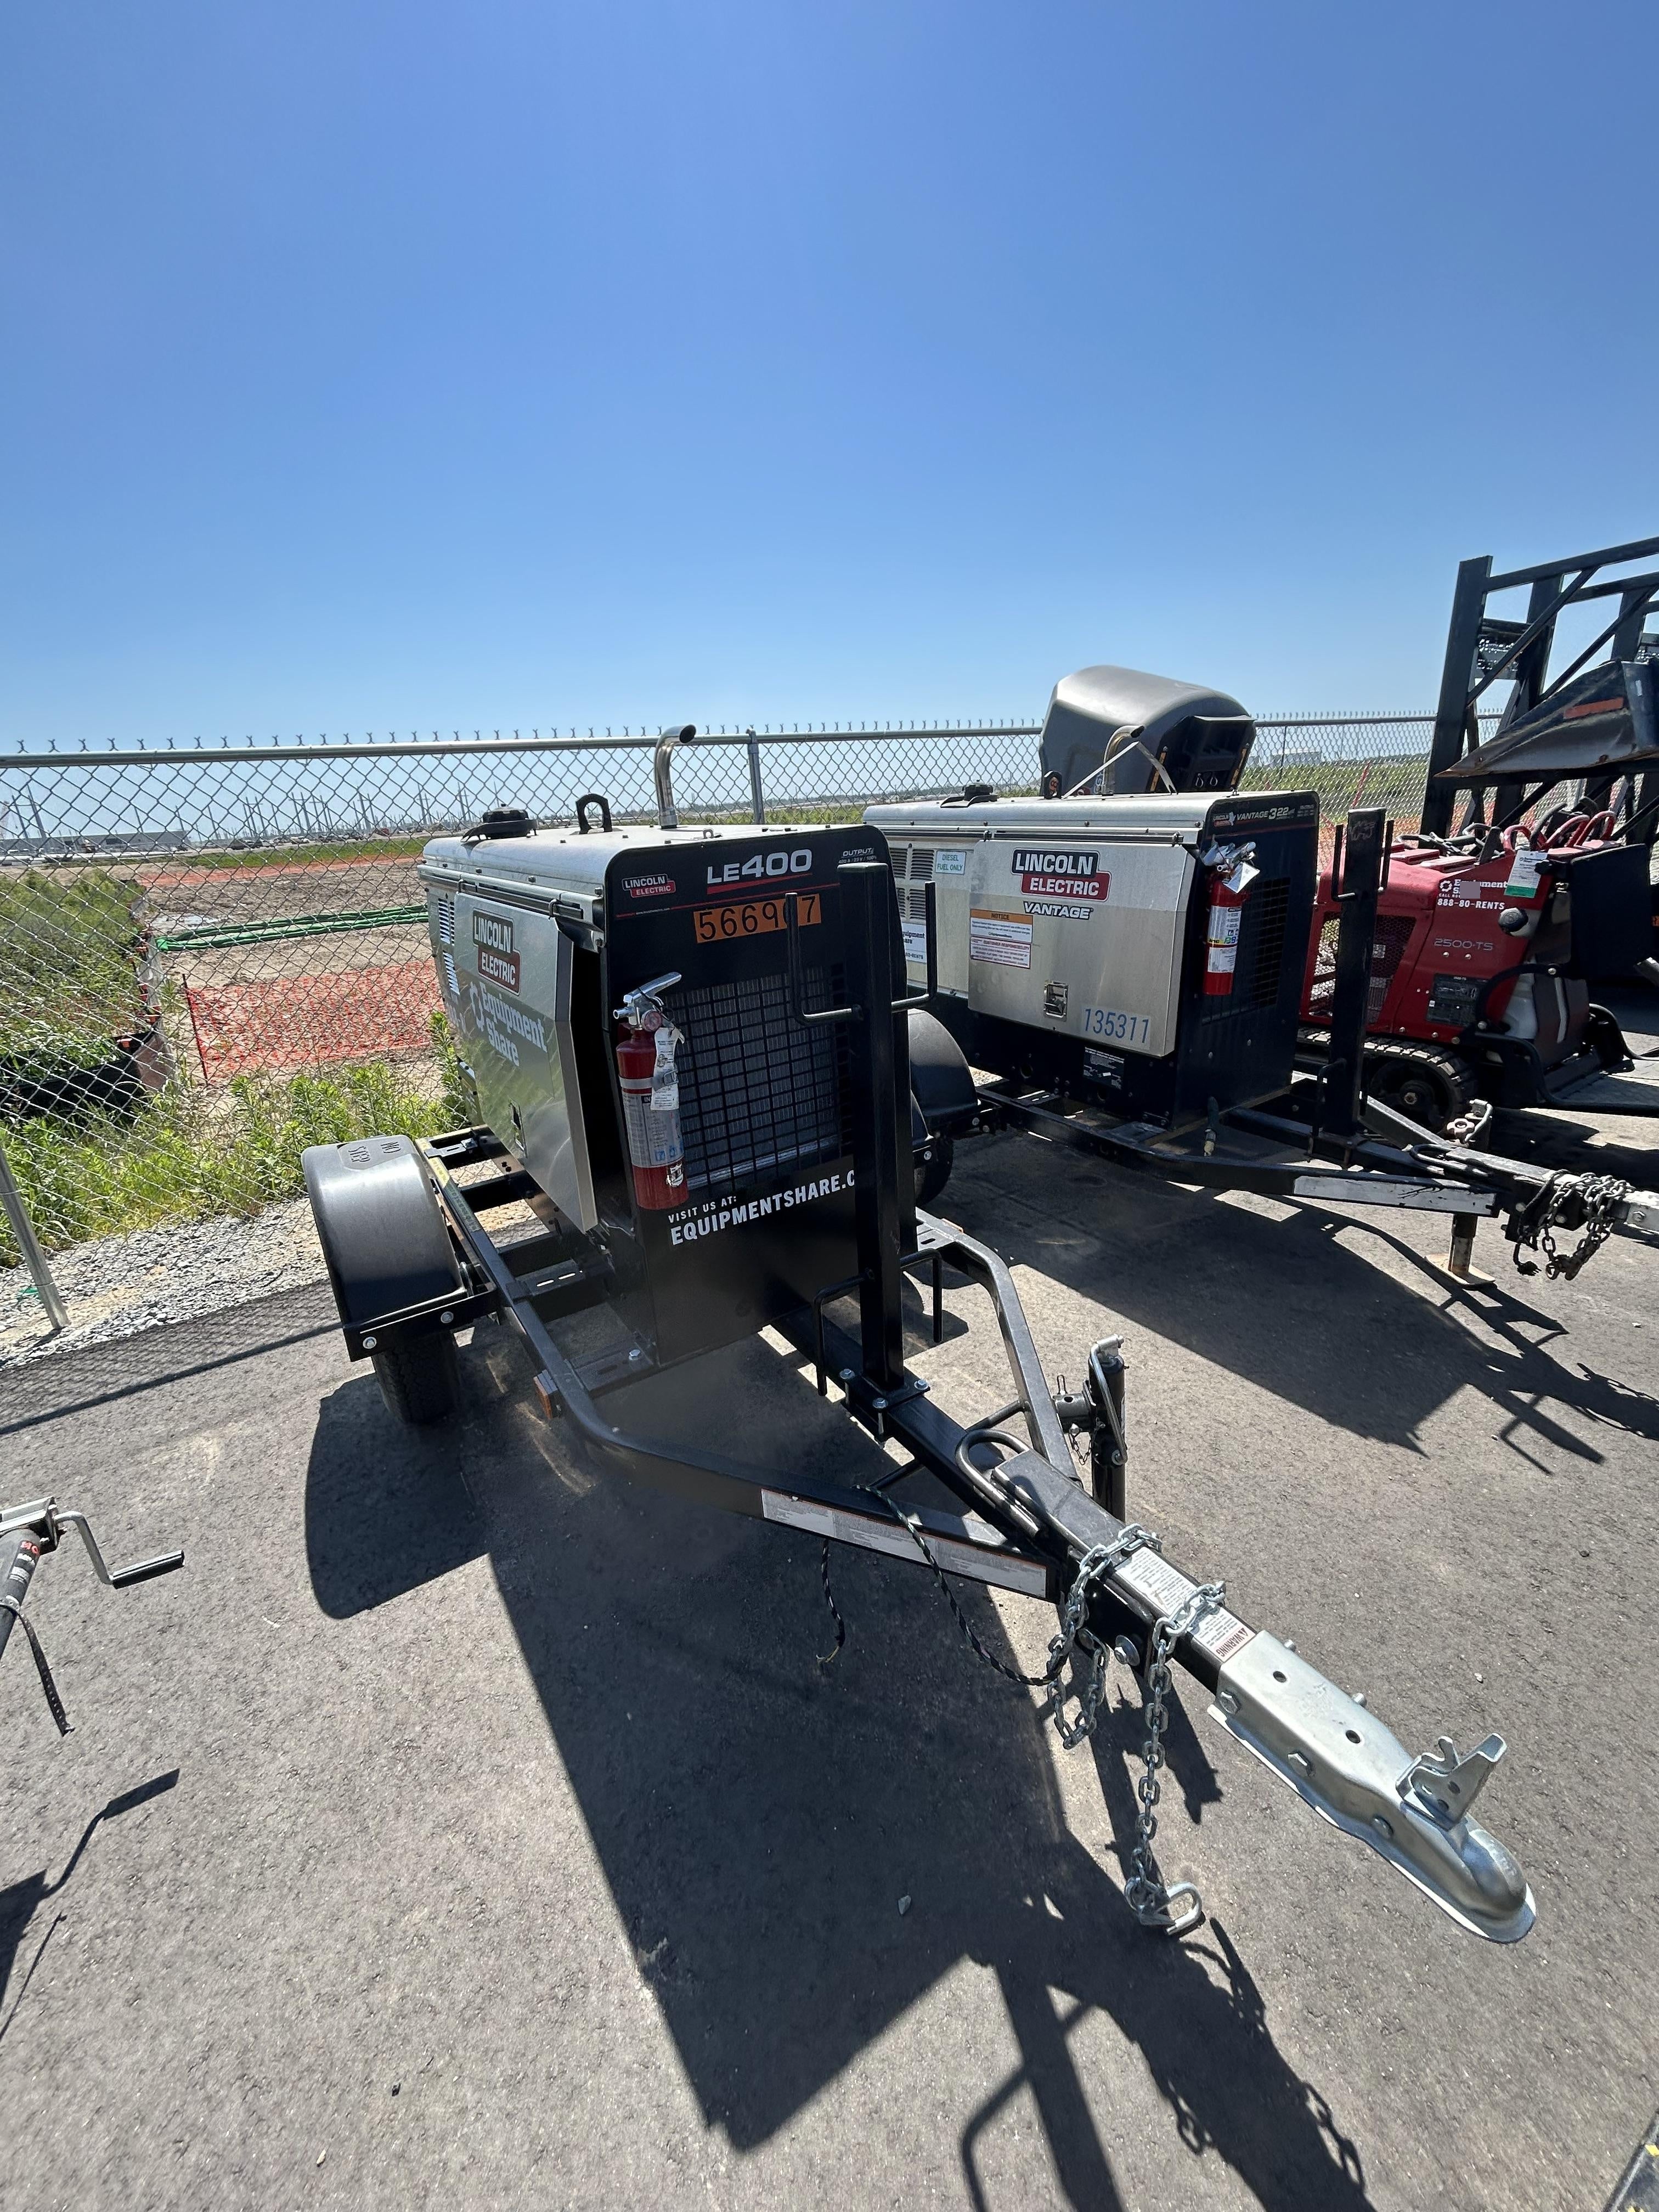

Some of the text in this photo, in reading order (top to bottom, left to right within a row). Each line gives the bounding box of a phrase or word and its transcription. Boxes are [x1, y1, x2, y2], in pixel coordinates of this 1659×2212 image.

[1237, 811, 1269, 821] VANTAGE
[1268, 806, 1289, 820] 322
[843, 848, 872, 856] OUTPUT
[707, 848, 812, 884] LE400
[1015, 853, 1094, 876] LINCOLN
[625, 876, 666, 889] LINCOLN
[636, 885, 672, 896] ELECTRIC
[1029, 877, 1099, 896] ELECTRIC
[1024, 902, 1091, 920] VANTAGE
[1437, 898, 1505, 910] 888-80-RENTS
[473, 916, 511, 953] LINCOLN
[481, 951, 516, 986] ELECTRIC
[479, 981, 548, 1053] Equipment
[1085, 1008, 1149, 1043] 135311
[348, 1146, 371, 1162] STEP
[380, 1142, 402, 1153] NO
[668, 1195, 737, 1224] VISIT US AT:
[670, 1169, 855, 1246] EQUIPMENTSHARE.C
[1215, 1633, 1245, 1657] WARNING
